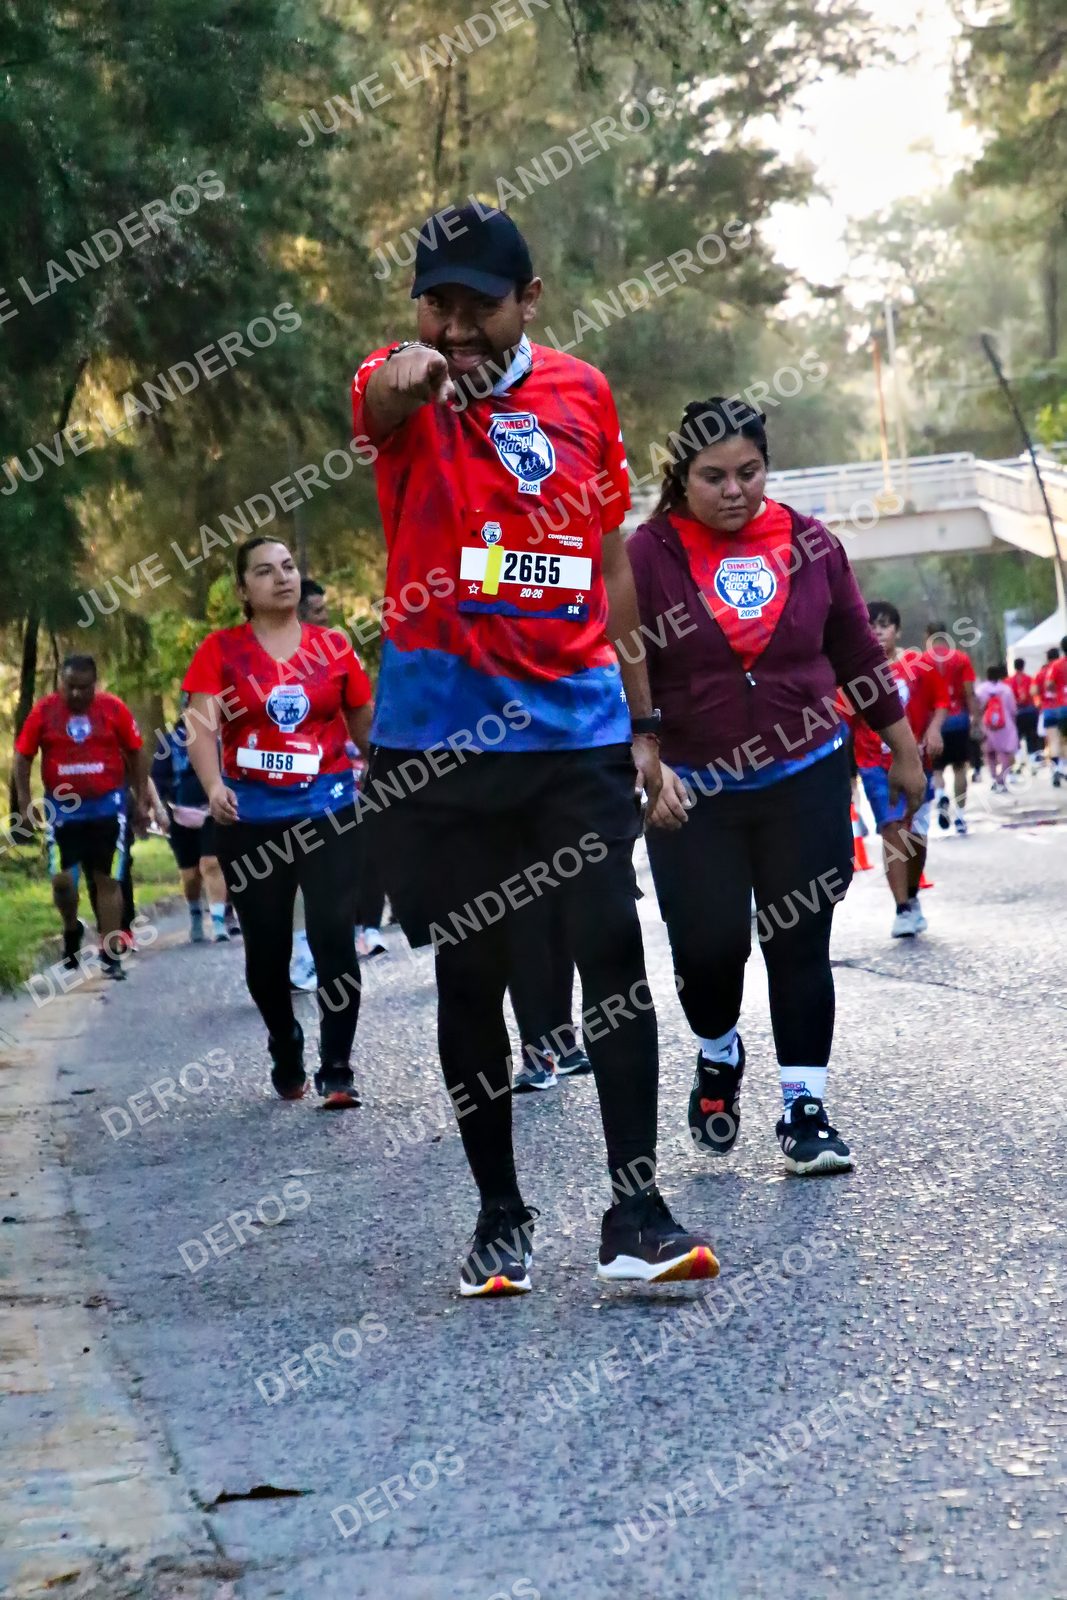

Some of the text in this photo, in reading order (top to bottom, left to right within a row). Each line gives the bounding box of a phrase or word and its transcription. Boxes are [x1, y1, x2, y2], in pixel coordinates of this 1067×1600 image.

[500, 440, 528, 453] Race
[504, 552, 561, 585] 2655
[729, 572, 760, 582] Global
[724, 581, 749, 590] Race
[568, 605, 580, 615] 5K
[740, 609, 759, 617] 2026
[261, 752, 293, 771] 1858
